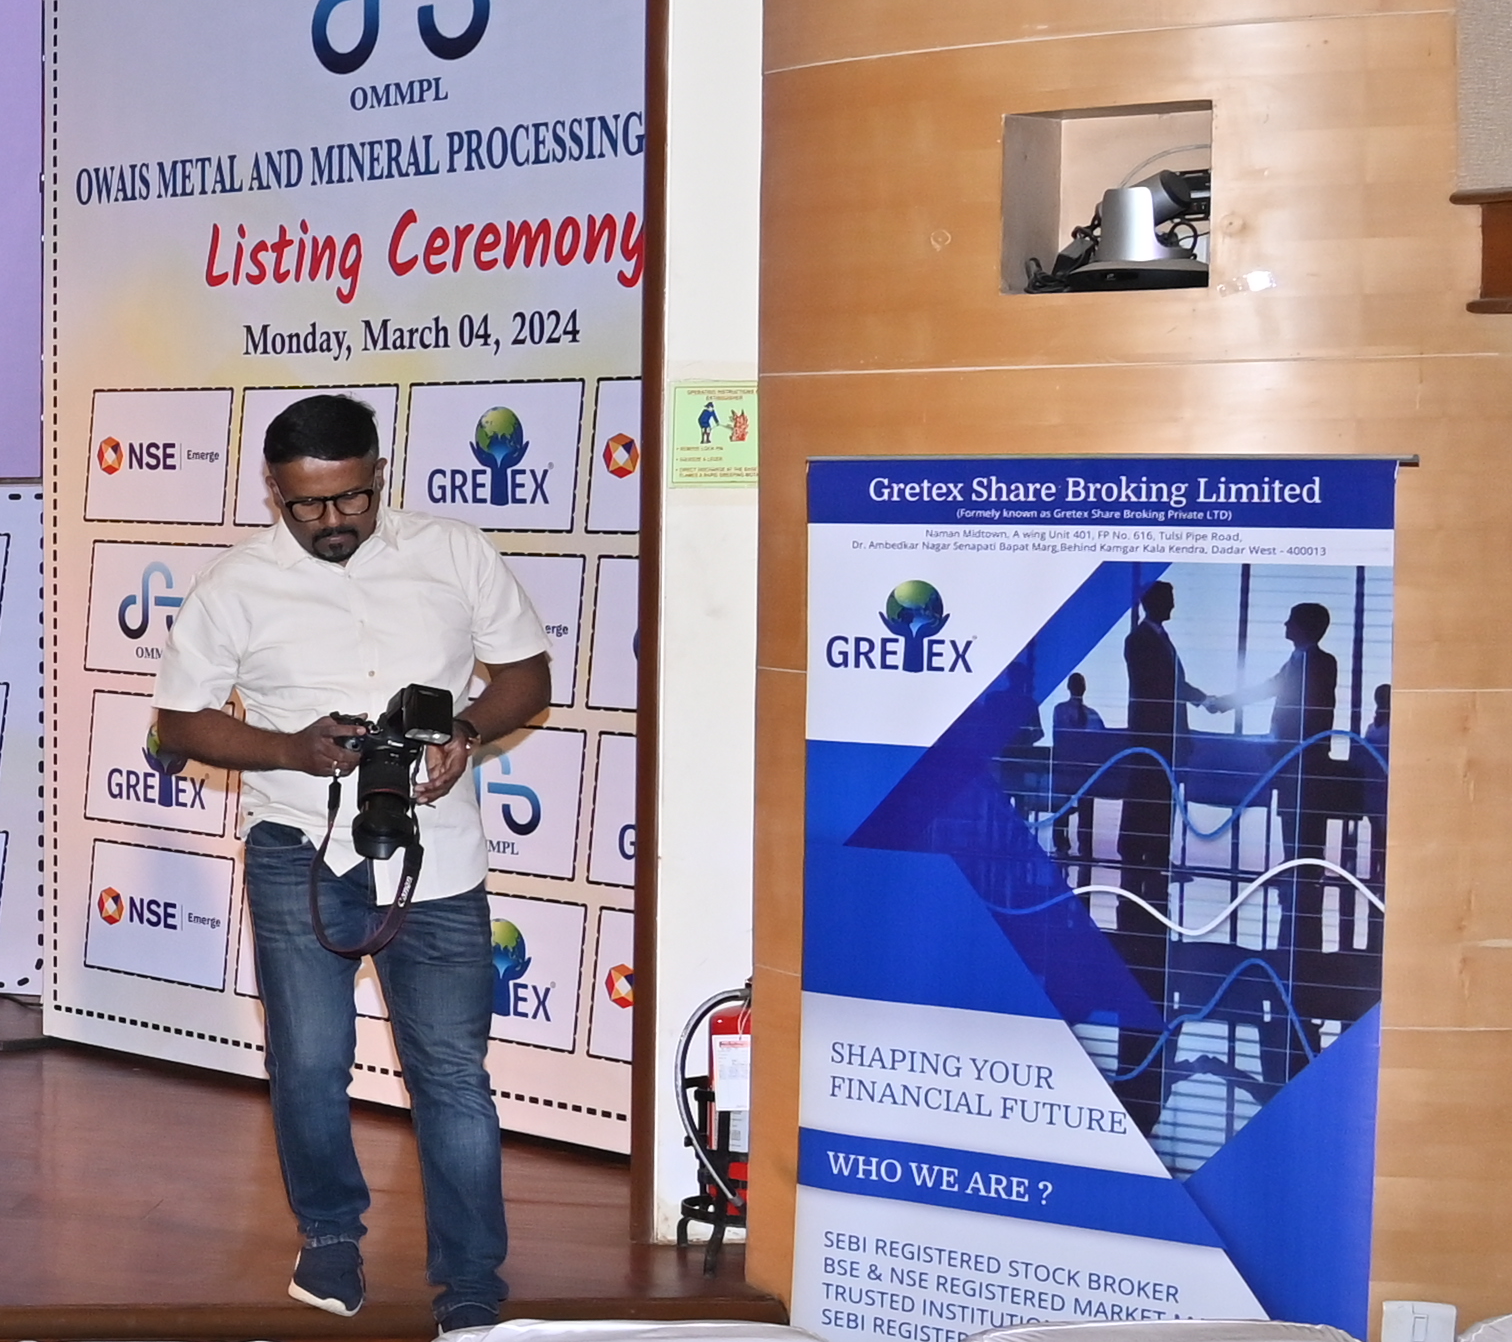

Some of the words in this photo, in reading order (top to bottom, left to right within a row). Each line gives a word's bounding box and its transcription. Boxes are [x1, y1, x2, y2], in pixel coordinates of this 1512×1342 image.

[349, 77, 449, 110] OMMPL
[75, 163, 151, 205] OWAIS
[156, 155, 244, 198] METAL
[247, 149, 304, 191] AND
[310, 135, 440, 186] MINERAL
[445, 110, 646, 173] PROCESSING
[205, 219, 363, 304] Listing
[387, 204, 645, 288] Ceremony
[242, 322, 352, 361] Monday,
[361, 316, 451, 351] March
[458, 314, 501, 354] 04,
[510, 309, 581, 345] 2024
[128, 441, 177, 471] NSE
[186, 449, 220, 464] Emerge
[868, 477, 964, 502] Gretex
[971, 475, 1057, 502] Share
[1064, 476, 1189, 507] Broking
[1196, 476, 1322, 504] Limited
[1002, 508, 1038, 519] known
[1039, 510, 1052, 519] as
[1052, 508, 1089, 519] Gretex
[1091, 508, 1122, 519] Share
[1123, 508, 1166, 522] Broking
[1167, 509, 1205, 520] Private
[1206, 509, 1233, 522] LTD)
[129, 897, 178, 930] NSE
[830, 1042, 963, 1077] SHAPING
[968, 1058, 1055, 1089] YOUR
[829, 1076, 993, 1117] FINANCIAL
[1000, 1097, 1129, 1134] FUTURE
[826, 1151, 903, 1182] WHO
[908, 1161, 959, 1192] WE
[964, 1172, 1029, 1202] ARE
[1037, 1180, 1053, 1206] ?
[823, 1230, 867, 1254] SEBI
[875, 1239, 1002, 1273] REGISTERED
[1008, 1259, 1081, 1288] STOCK
[1088, 1273, 1179, 1303] BROKER
[823, 1256, 860, 1279] BSE
[867, 1263, 883, 1282] &
[890, 1266, 929, 1290] NSE
[936, 1275, 1066, 1311] REGISTERED
[821, 1308, 865, 1331] SEBI
[822, 1282, 915, 1313] TRUSTED
